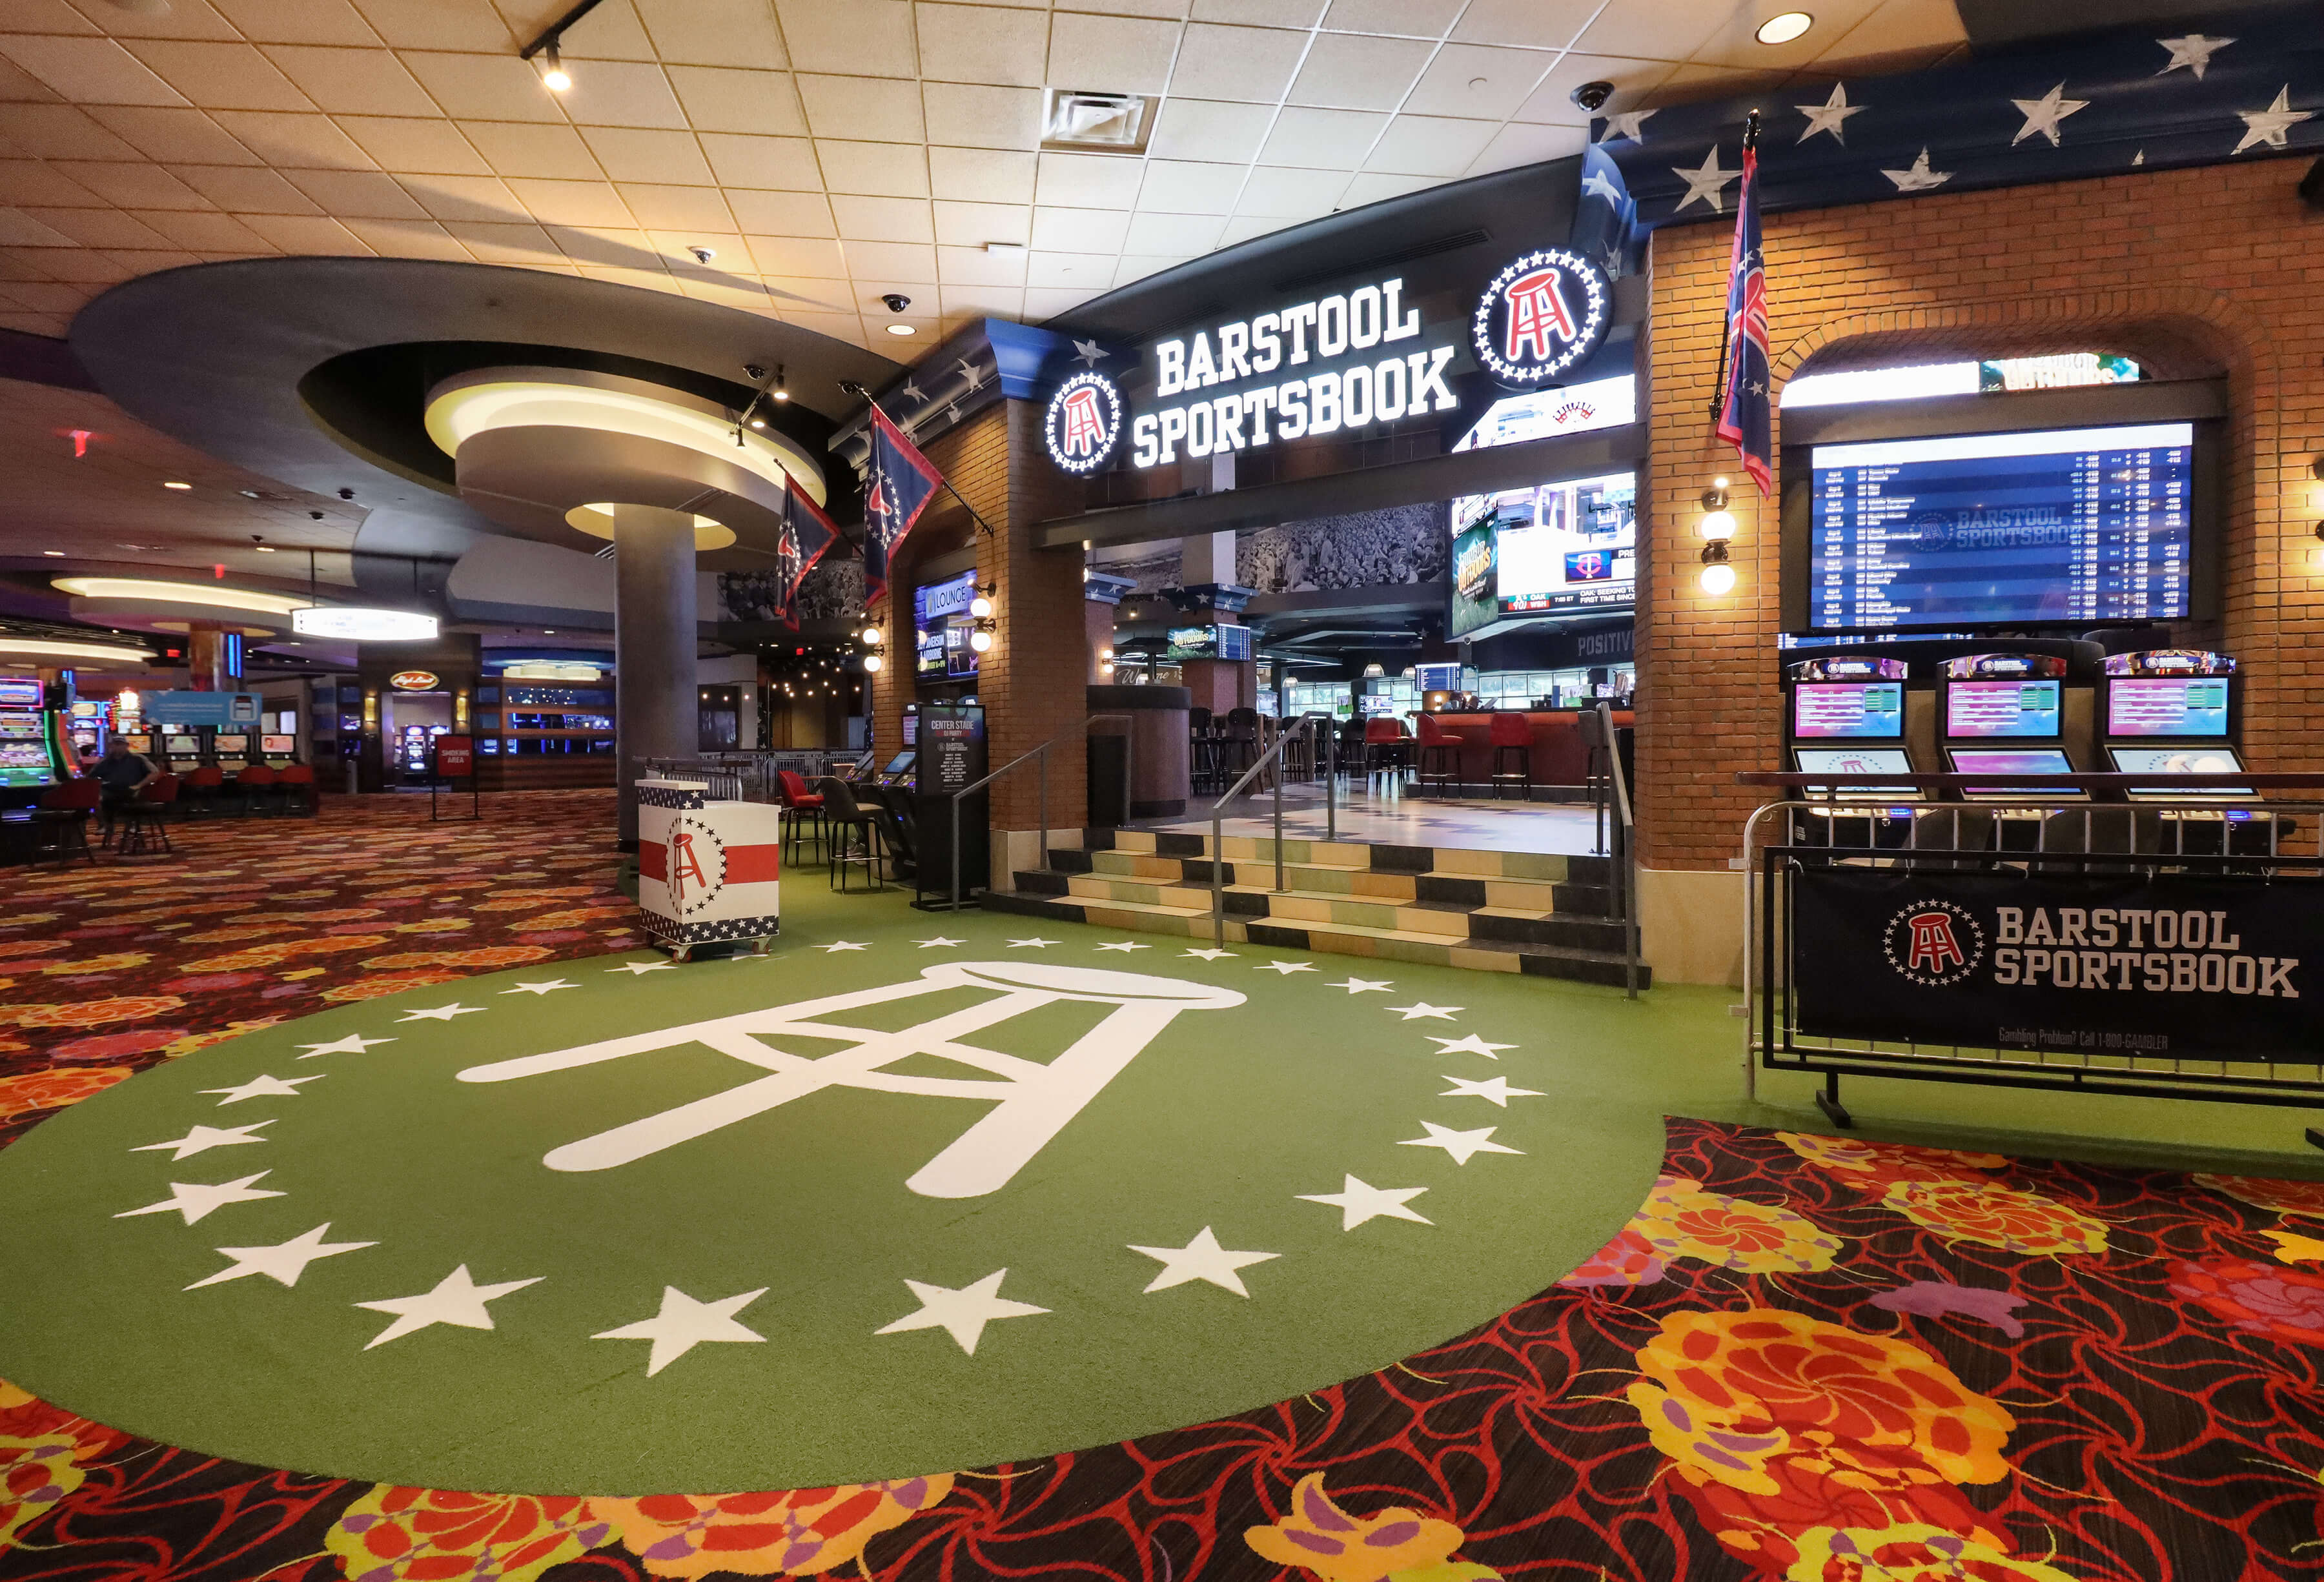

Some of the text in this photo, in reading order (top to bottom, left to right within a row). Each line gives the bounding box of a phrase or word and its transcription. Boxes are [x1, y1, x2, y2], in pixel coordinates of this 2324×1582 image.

[1157, 278, 1419, 397] BARSTOOL
[1133, 345, 1457, 469] SPORTSBOOK
[1957, 507, 2062, 529] BARSTOOL
[936, 587, 966, 608] LOUNGE
[1578, 630, 1635, 656] POSITIV
[932, 720, 954, 729] CENTER
[1996, 907, 2240, 950] BARSTOOL
[1994, 948, 2299, 998] SPORTSBOOK
[1999, 1027, 2168, 1050] Gambling Problem? Call 1-800-GAMBLER
